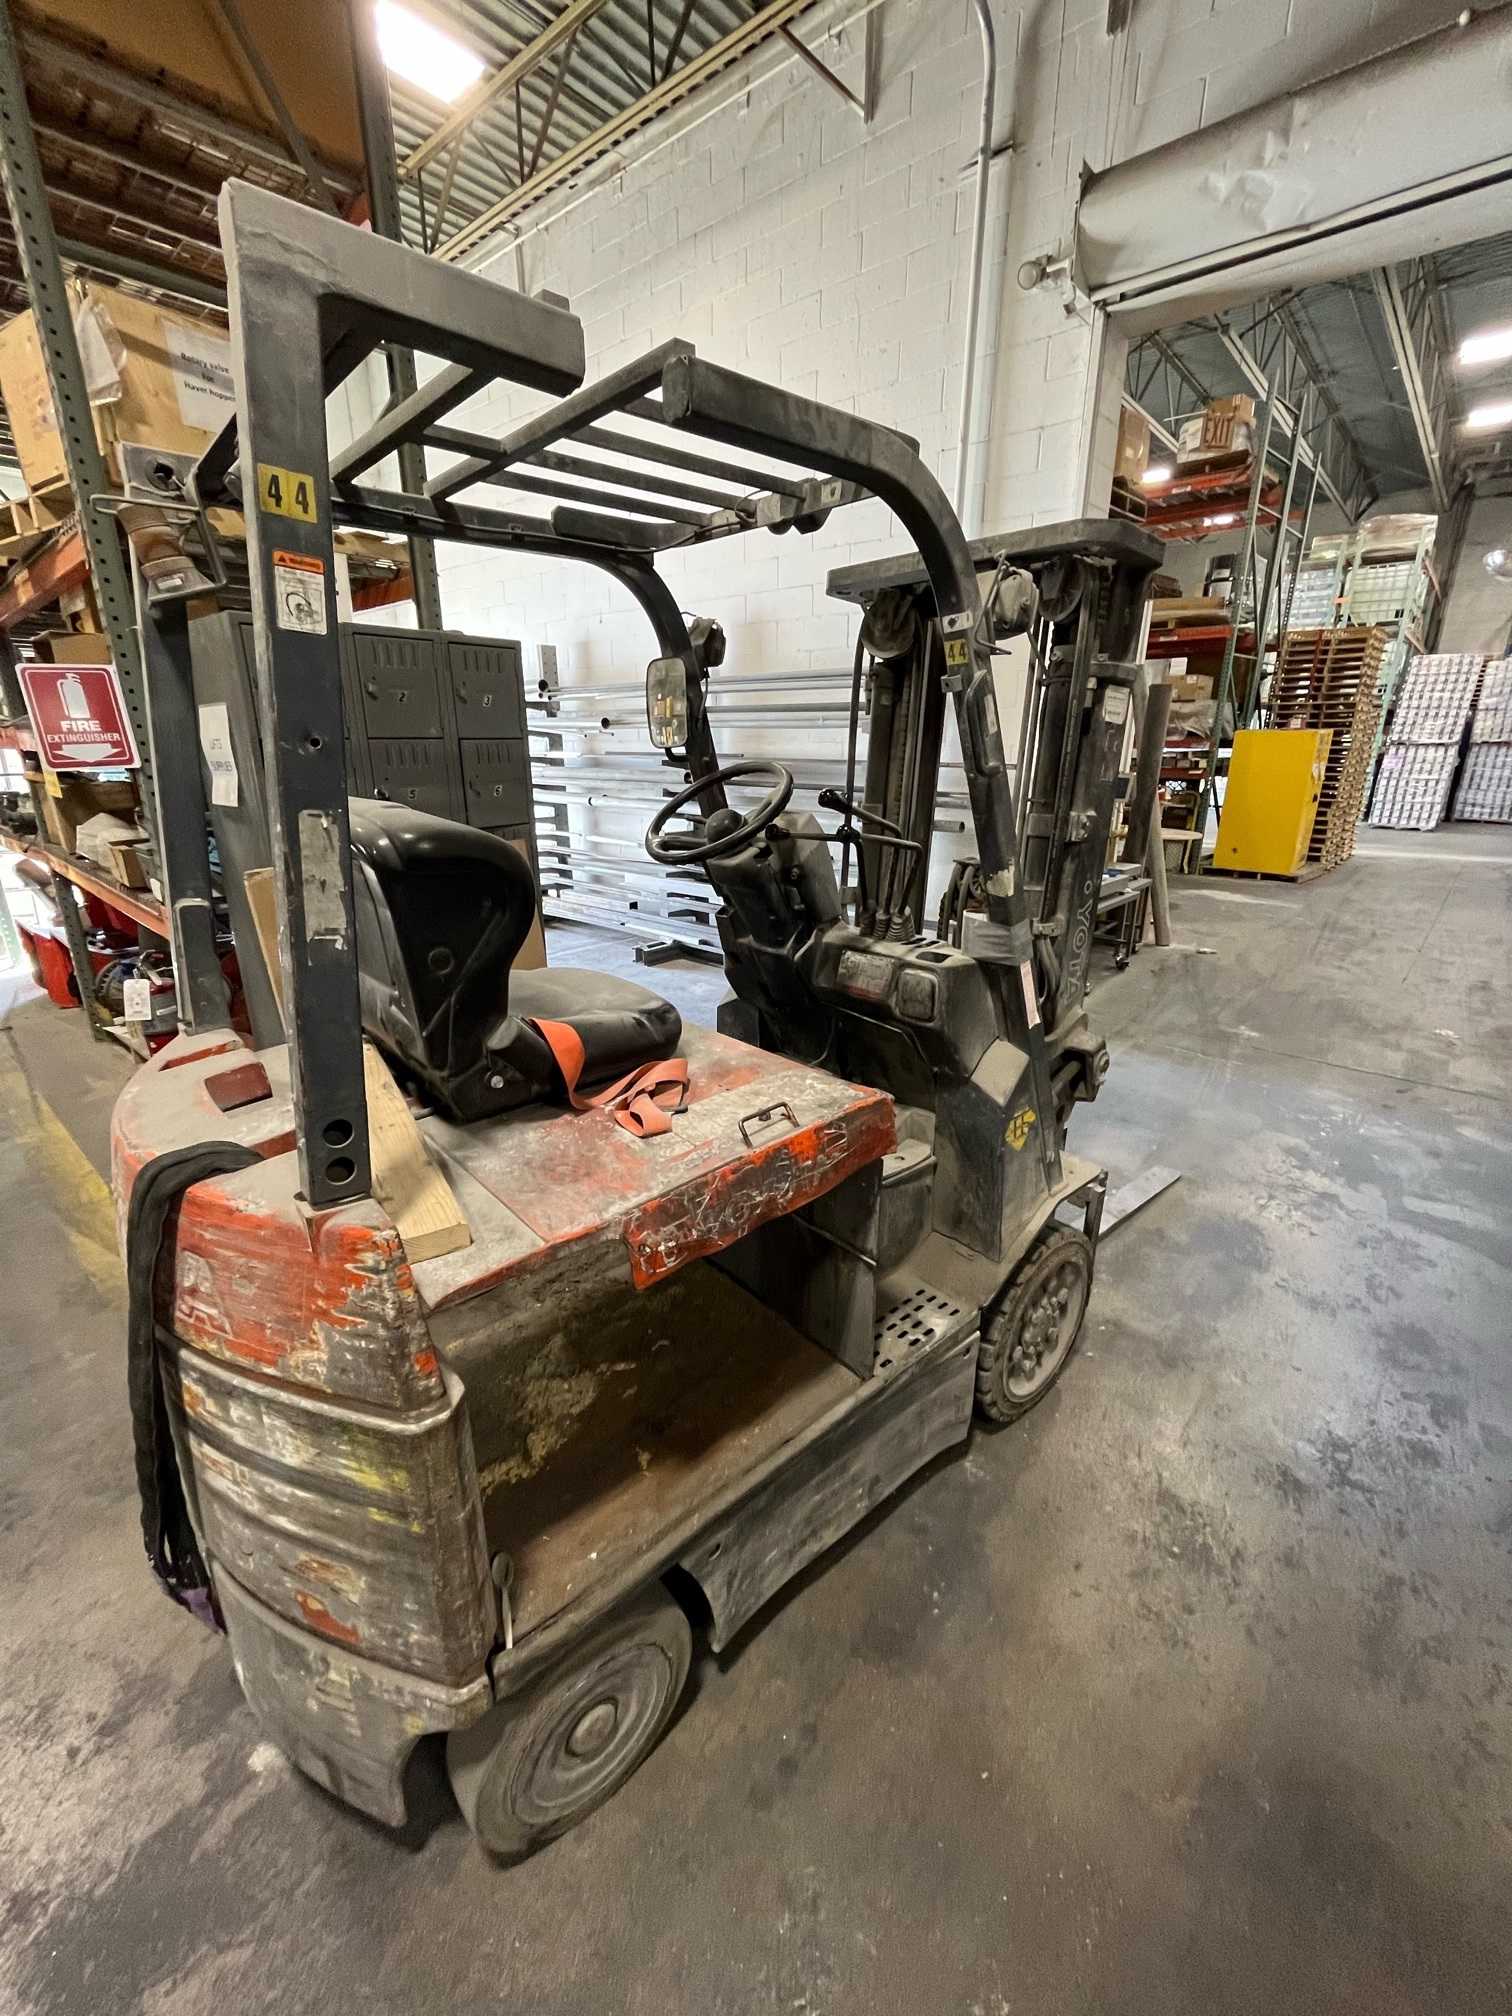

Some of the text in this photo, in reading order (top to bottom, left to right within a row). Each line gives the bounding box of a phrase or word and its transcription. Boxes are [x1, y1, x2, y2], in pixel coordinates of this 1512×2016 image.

[1203, 414, 1233, 444] EXIT
[268, 474, 309, 514] 44
[948, 642, 966, 662] 44
[60, 720, 101, 732] FIRE
[47, 732, 120, 744] EXTINGUISHER
